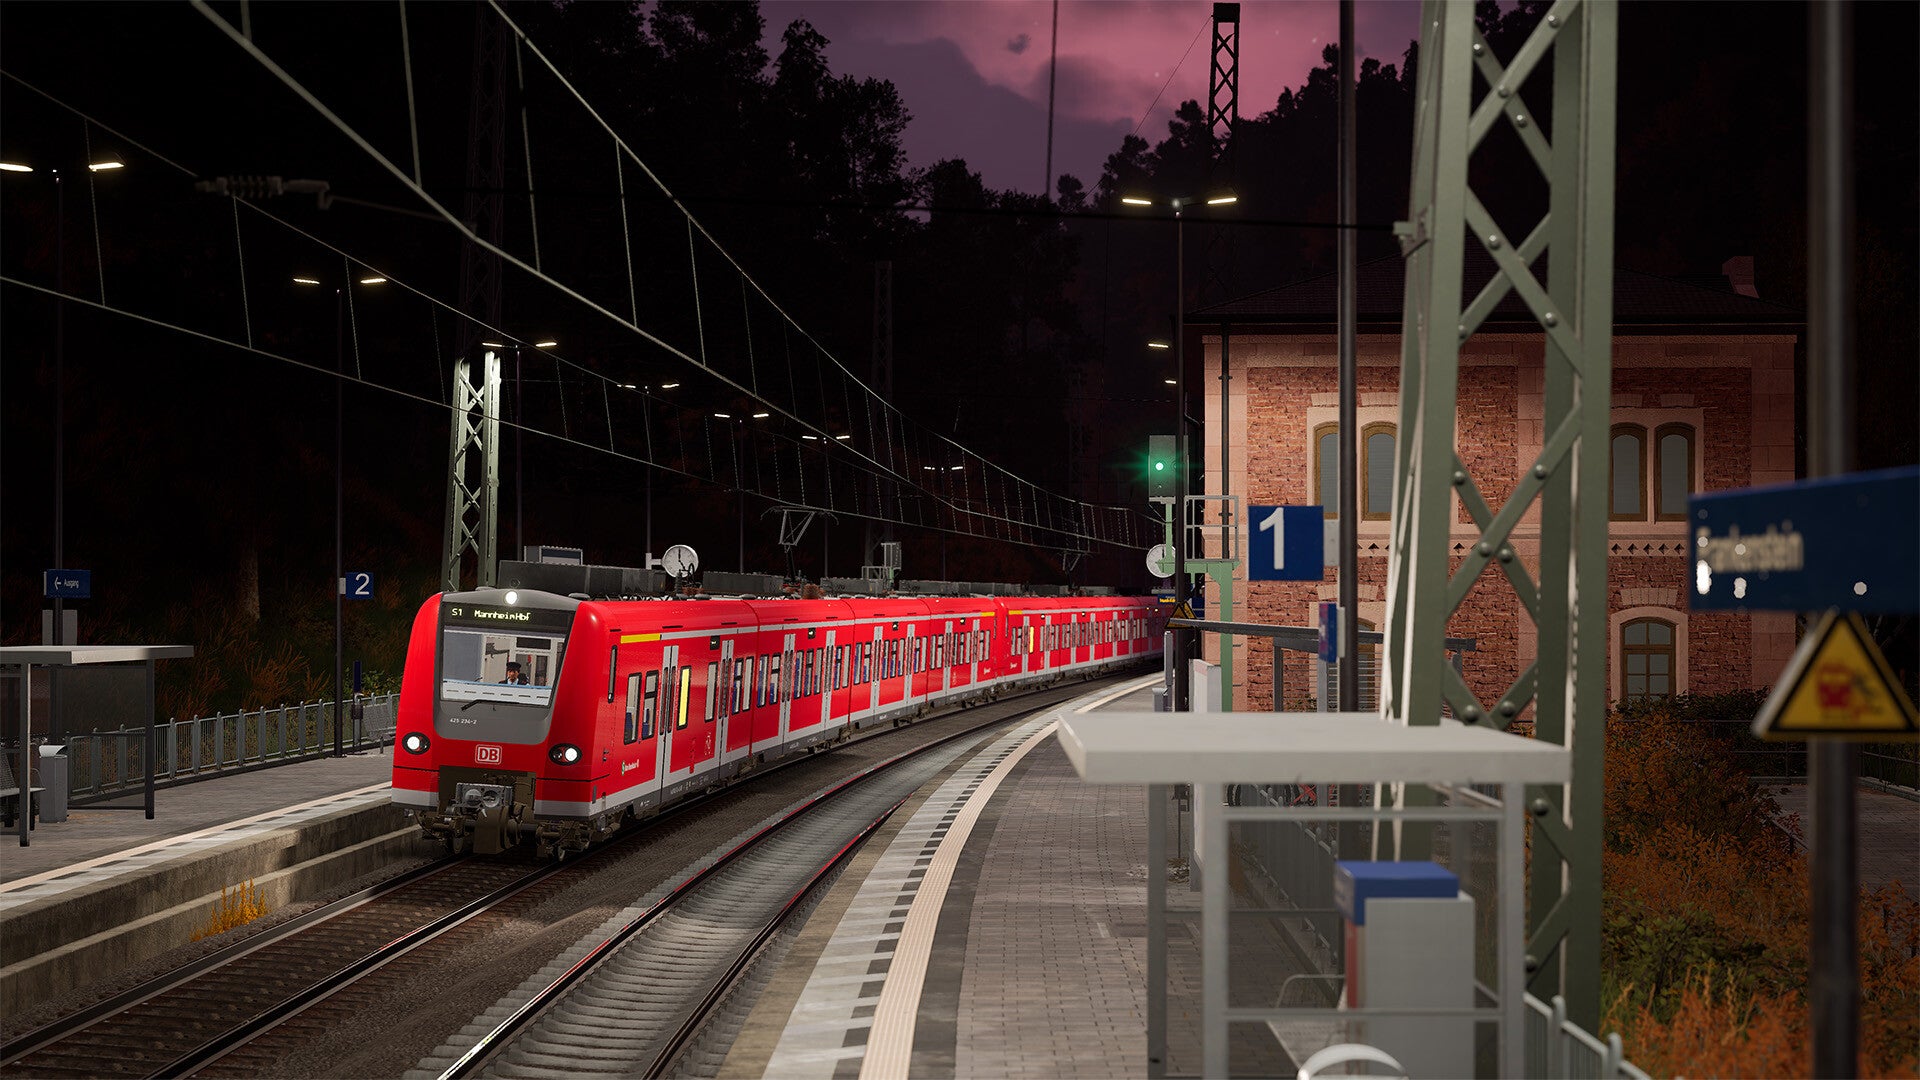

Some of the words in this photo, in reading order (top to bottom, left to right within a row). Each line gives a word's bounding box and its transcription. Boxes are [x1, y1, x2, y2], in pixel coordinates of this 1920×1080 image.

[1259, 507, 1284, 570] 1
[355, 573, 370, 595] 2
[451, 607, 463, 617] S1
[479, 748, 498, 761] DB
